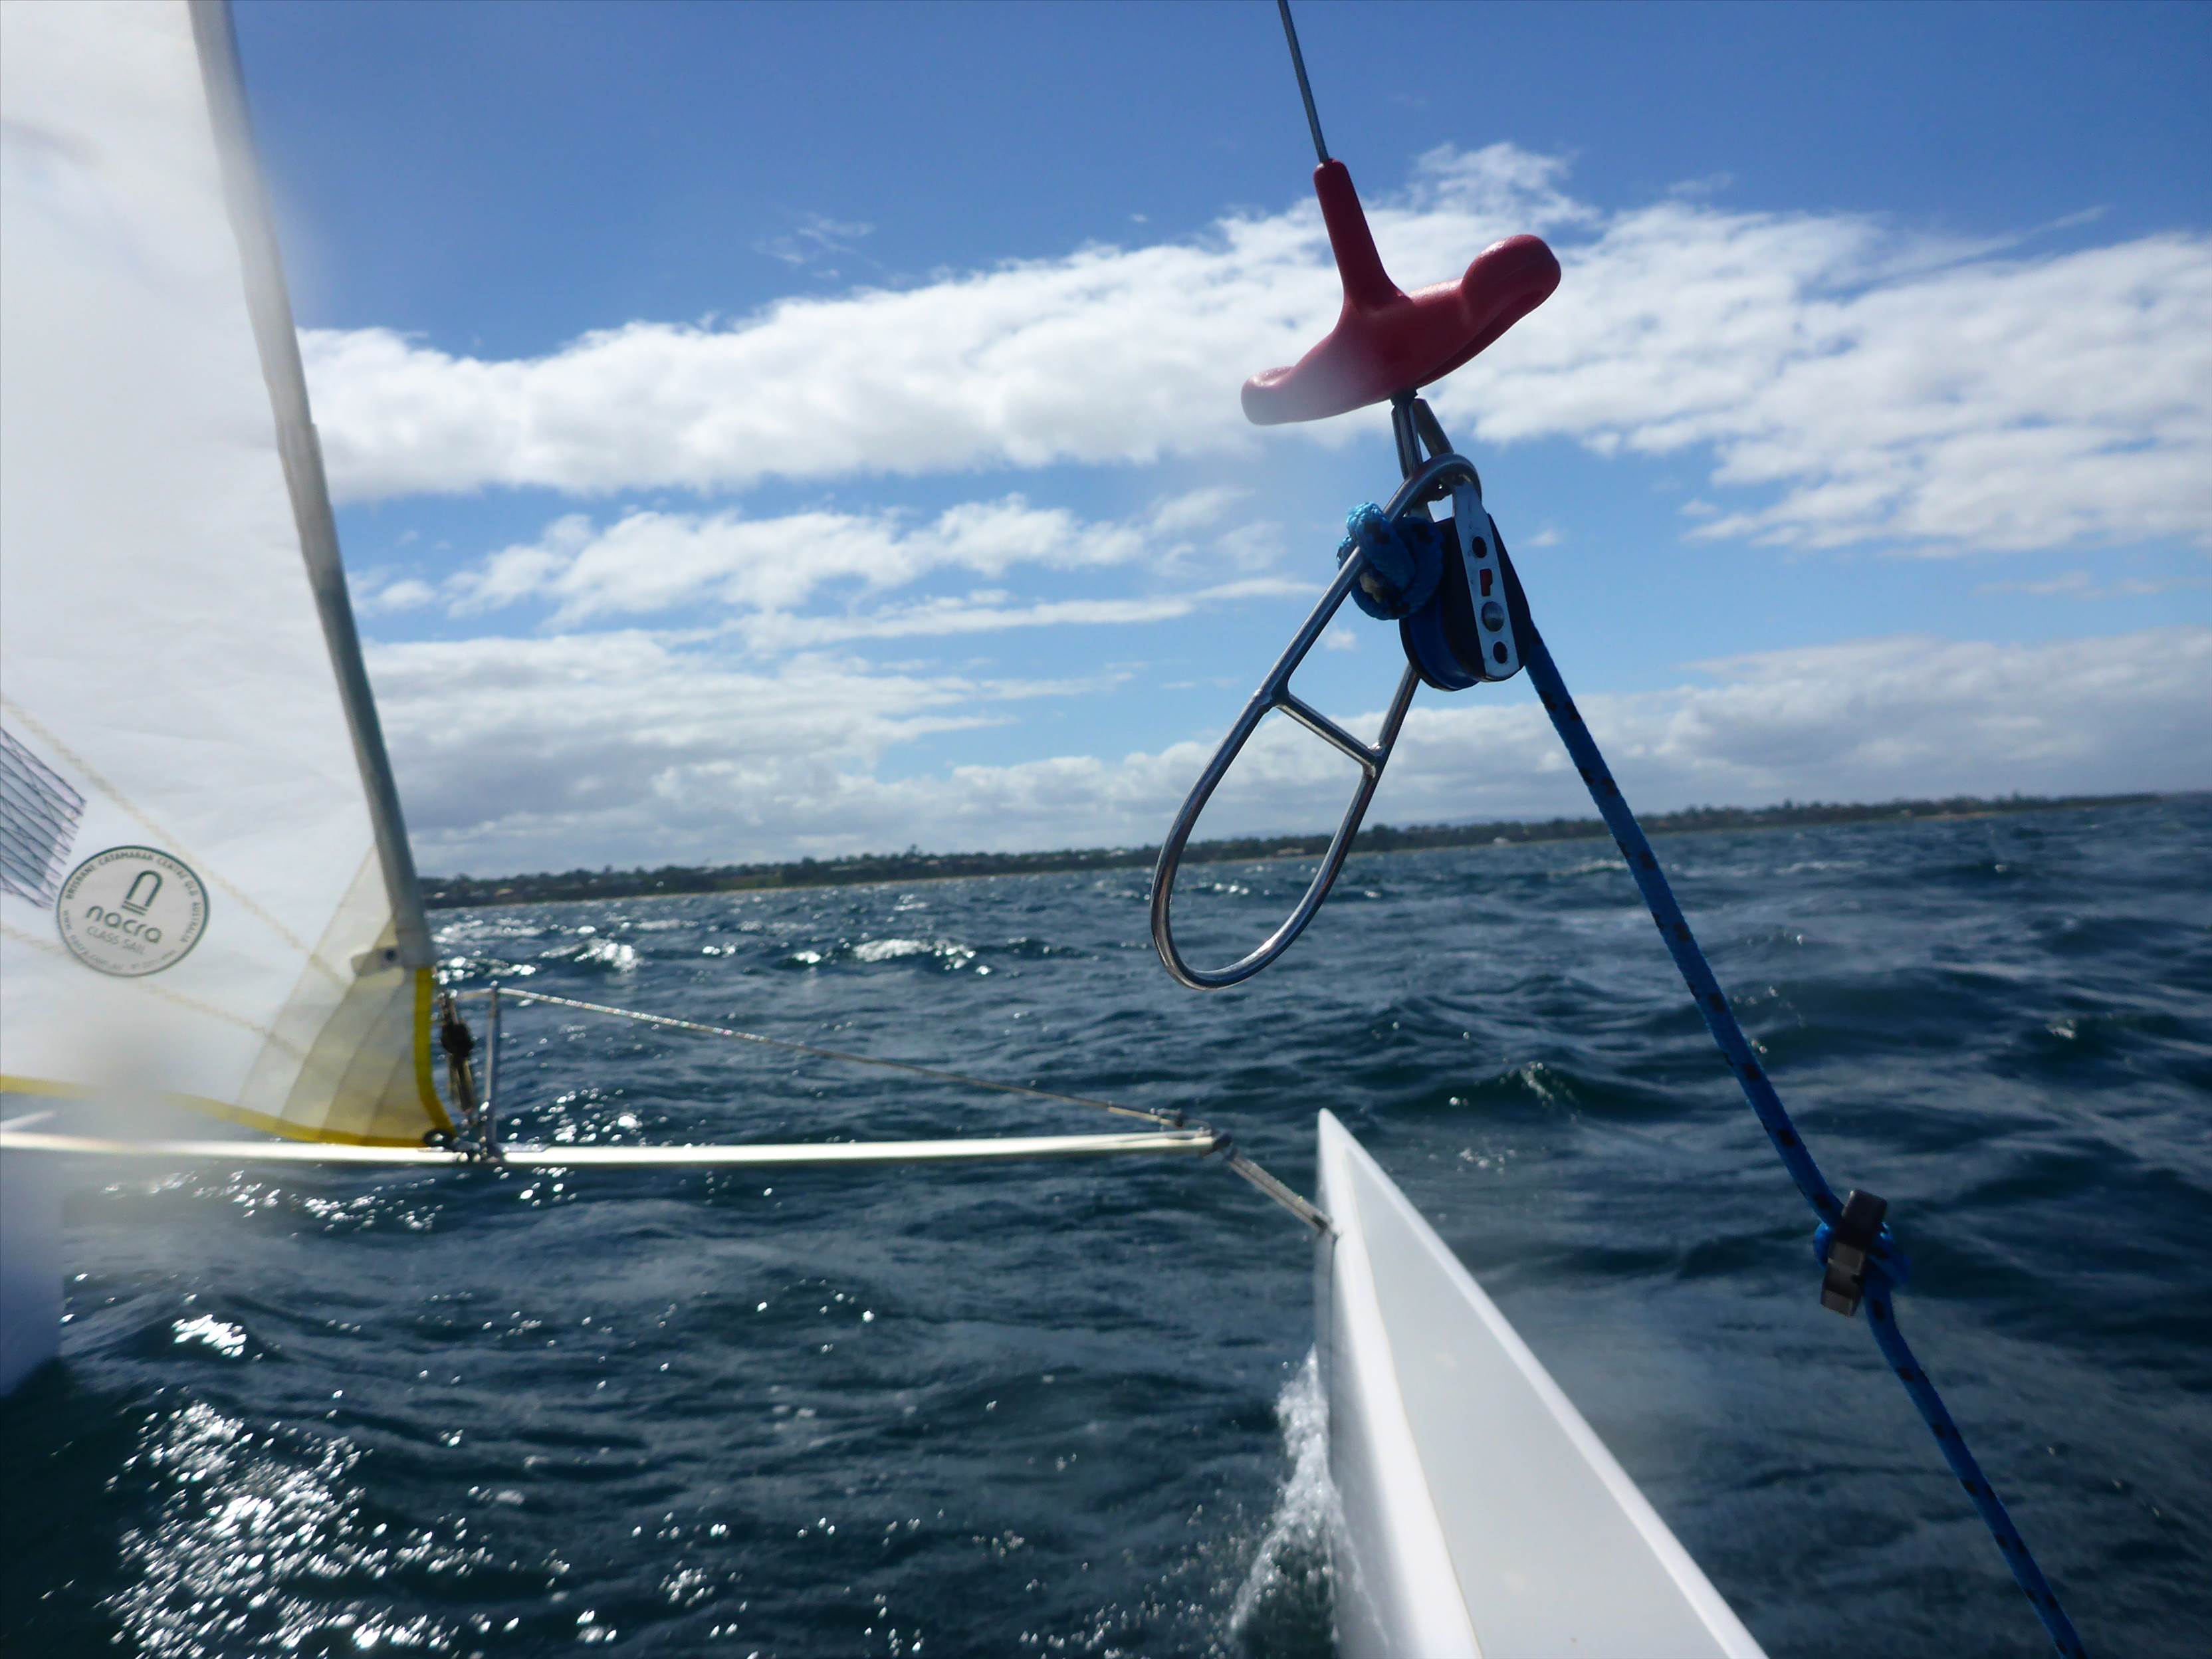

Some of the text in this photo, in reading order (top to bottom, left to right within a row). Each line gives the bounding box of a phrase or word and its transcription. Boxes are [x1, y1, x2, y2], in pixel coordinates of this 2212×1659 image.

[66, 864, 96, 899] BRISBANE
[99, 851, 154, 865] CATAMARAN
[180, 902, 201, 942] AUSTRALIA
[85, 905, 162, 944] nacra
[87, 925, 119, 945] CLASS
